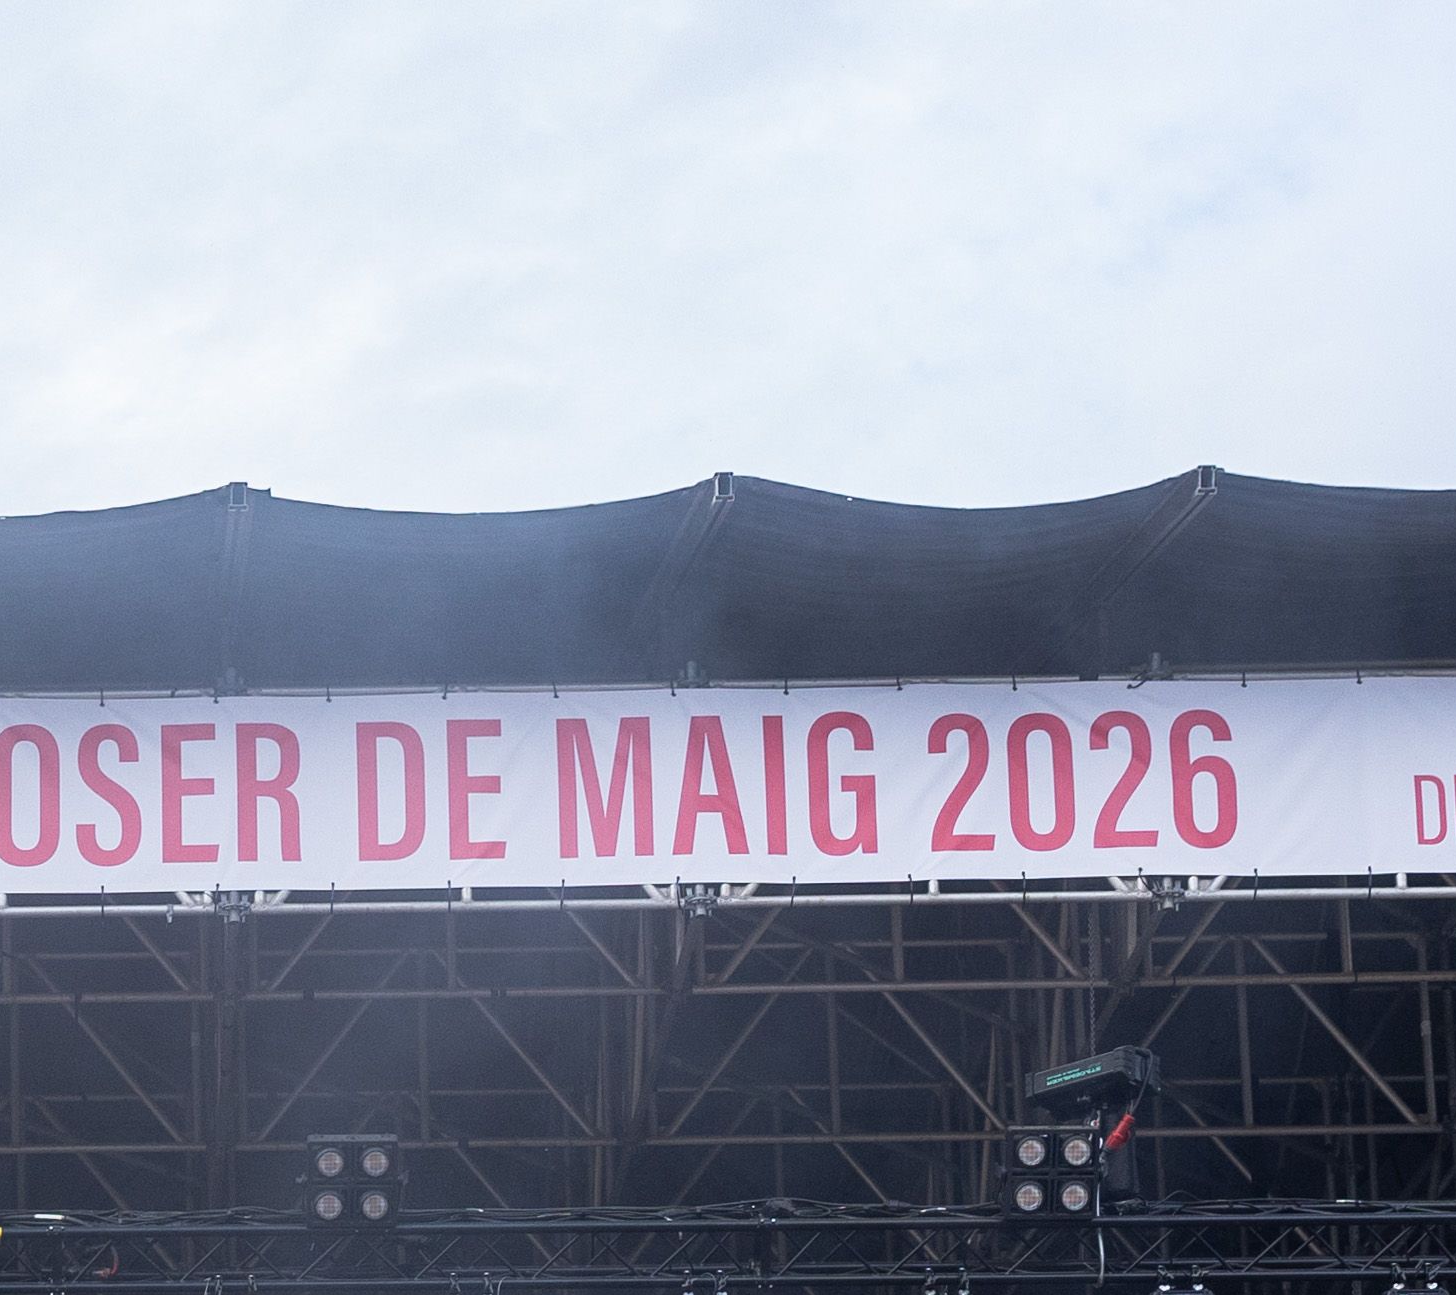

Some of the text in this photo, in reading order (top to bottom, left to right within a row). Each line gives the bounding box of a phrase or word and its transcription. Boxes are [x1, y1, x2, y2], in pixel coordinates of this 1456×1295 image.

[355, 718, 507, 862] DE
[556, 711, 878, 858] MAIG
[927, 709, 1238, 852] 2026
